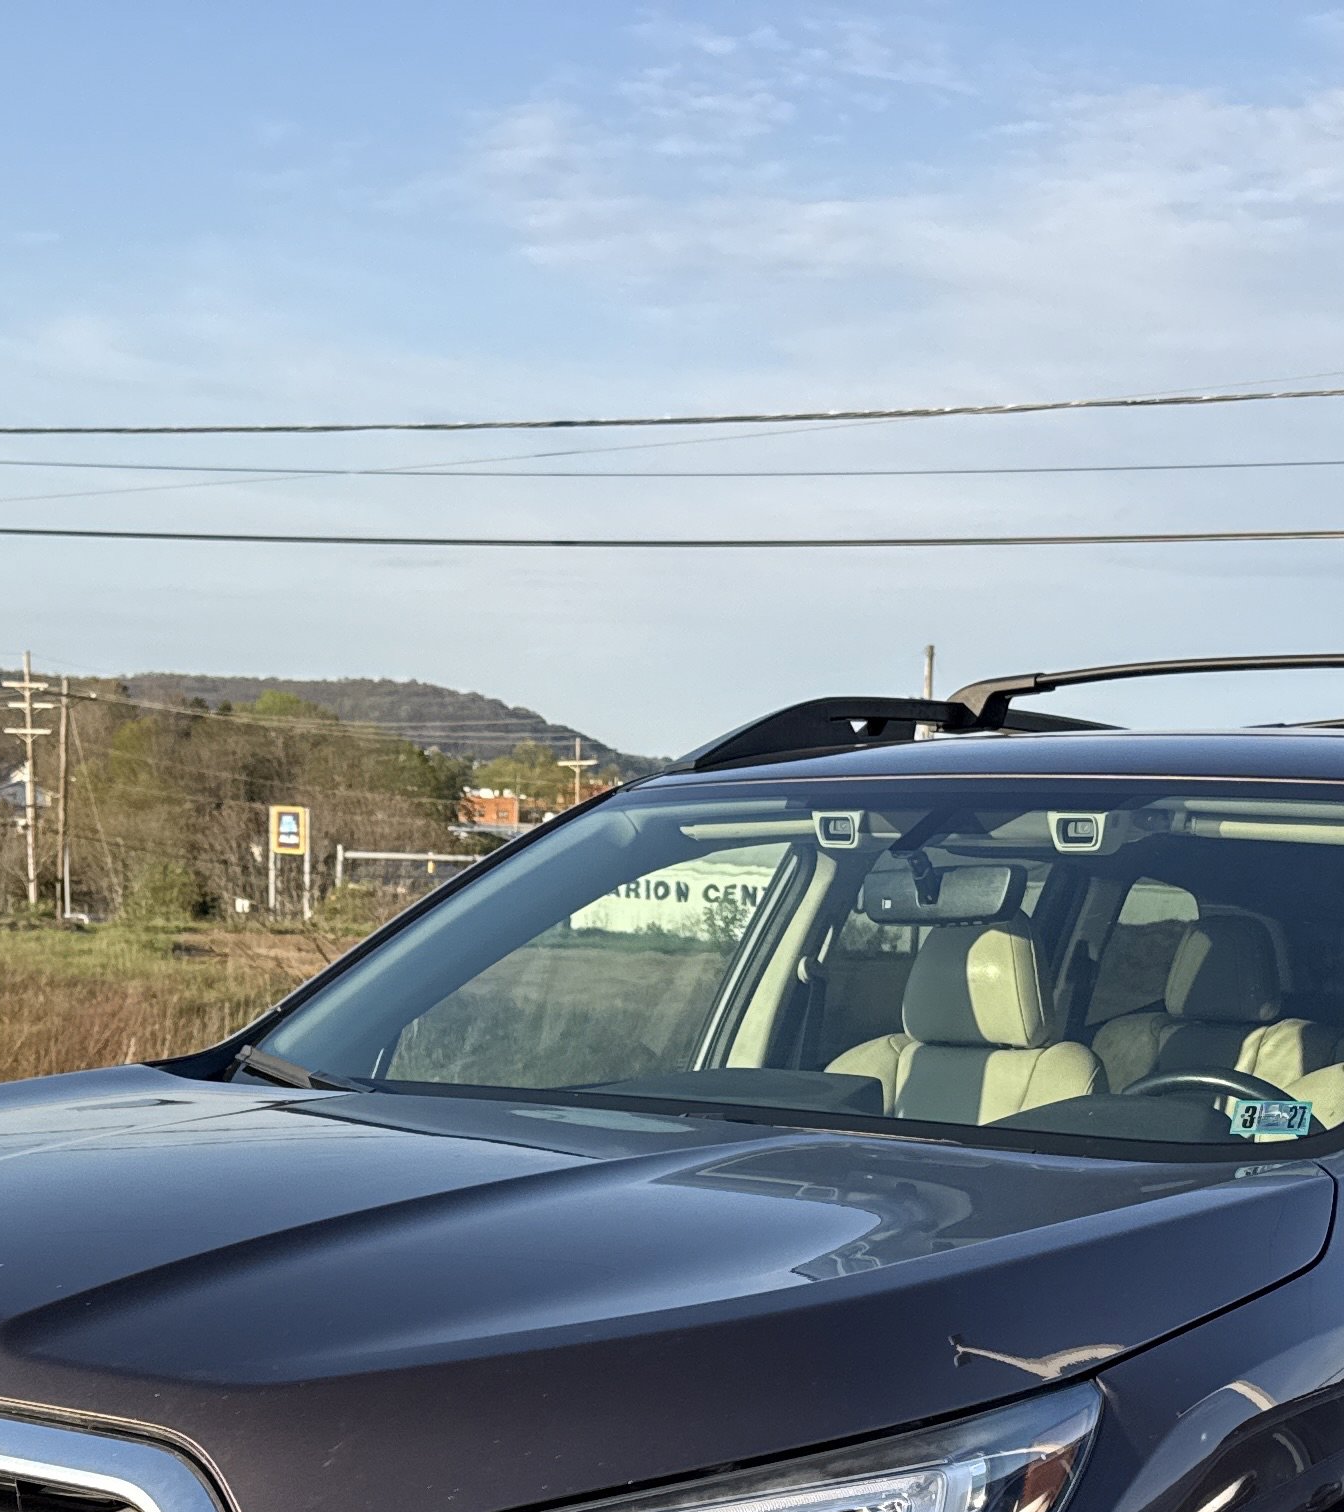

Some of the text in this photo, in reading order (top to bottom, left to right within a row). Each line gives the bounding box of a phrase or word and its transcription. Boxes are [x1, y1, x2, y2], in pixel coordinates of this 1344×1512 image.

[702, 883, 769, 907] CEN
[1241, 1105, 1308, 1129] 3 27
